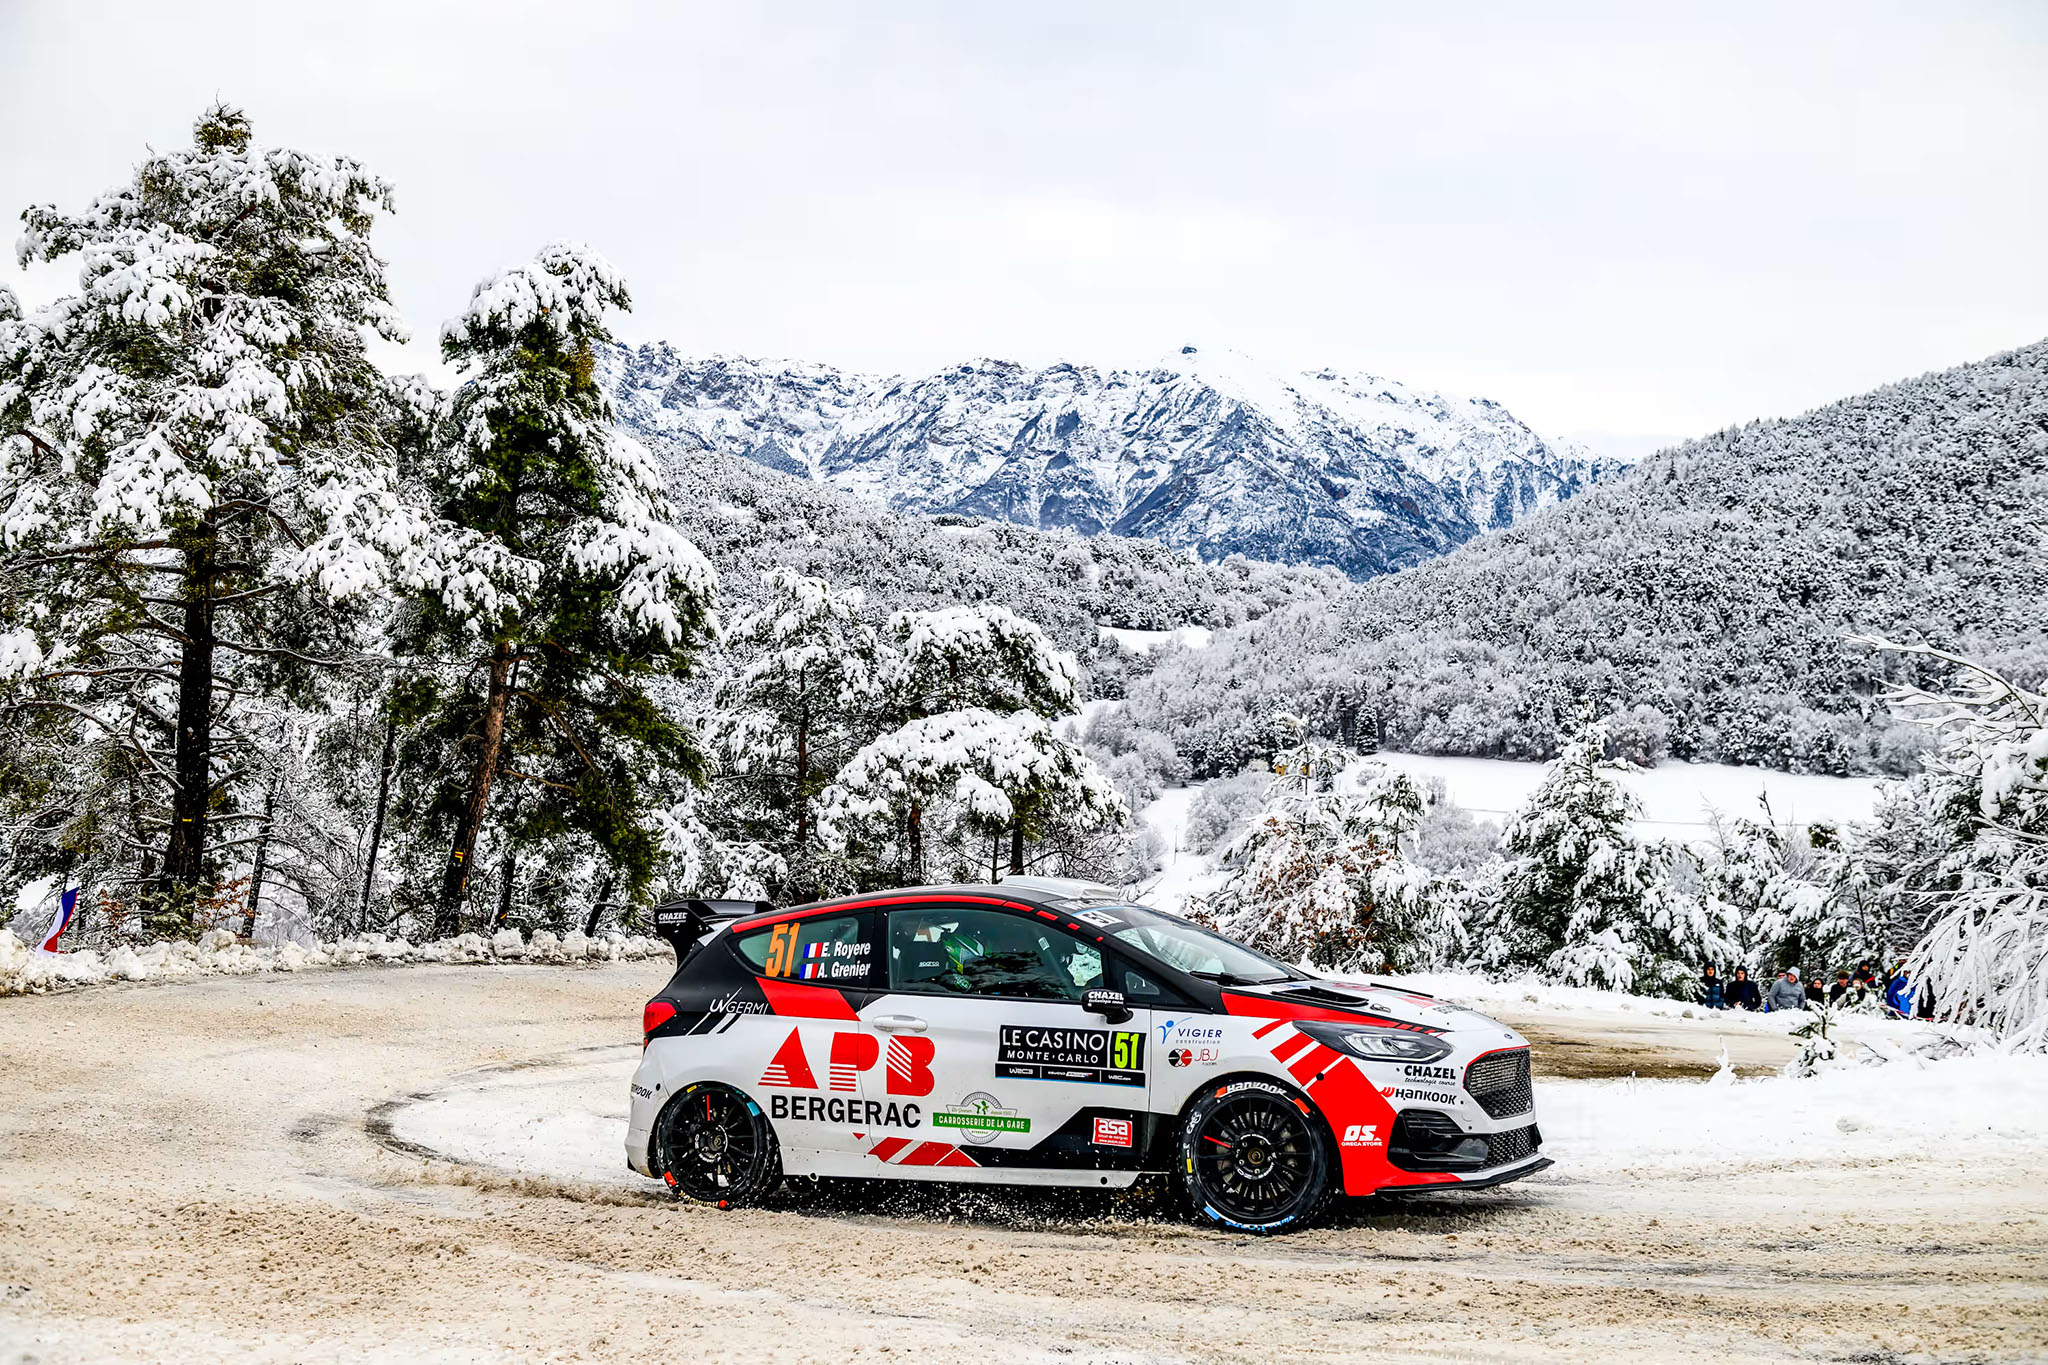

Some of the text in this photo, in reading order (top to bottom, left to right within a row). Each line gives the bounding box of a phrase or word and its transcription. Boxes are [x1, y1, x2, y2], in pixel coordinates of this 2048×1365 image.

[764, 922, 800, 978] 51
[821, 941, 871, 960] E. Royere
[817, 960, 871, 978] A. Grenier
[1002, 1029, 1105, 1051] LE CASINO
[1178, 1028, 1222, 1038] VIGIER
[1114, 1032, 1139, 1069] 51
[1194, 1048, 1218, 1062] JBJ
[757, 1026, 935, 1097] APB
[1404, 1065, 1456, 1080] CHAZEL
[1405, 1077, 1437, 1085] technologie
[771, 1095, 921, 1128] BERGERAC
[939, 1115, 1025, 1129] CARROSSERIE DE LA GARE
[1098, 1119, 1128, 1136] asa
